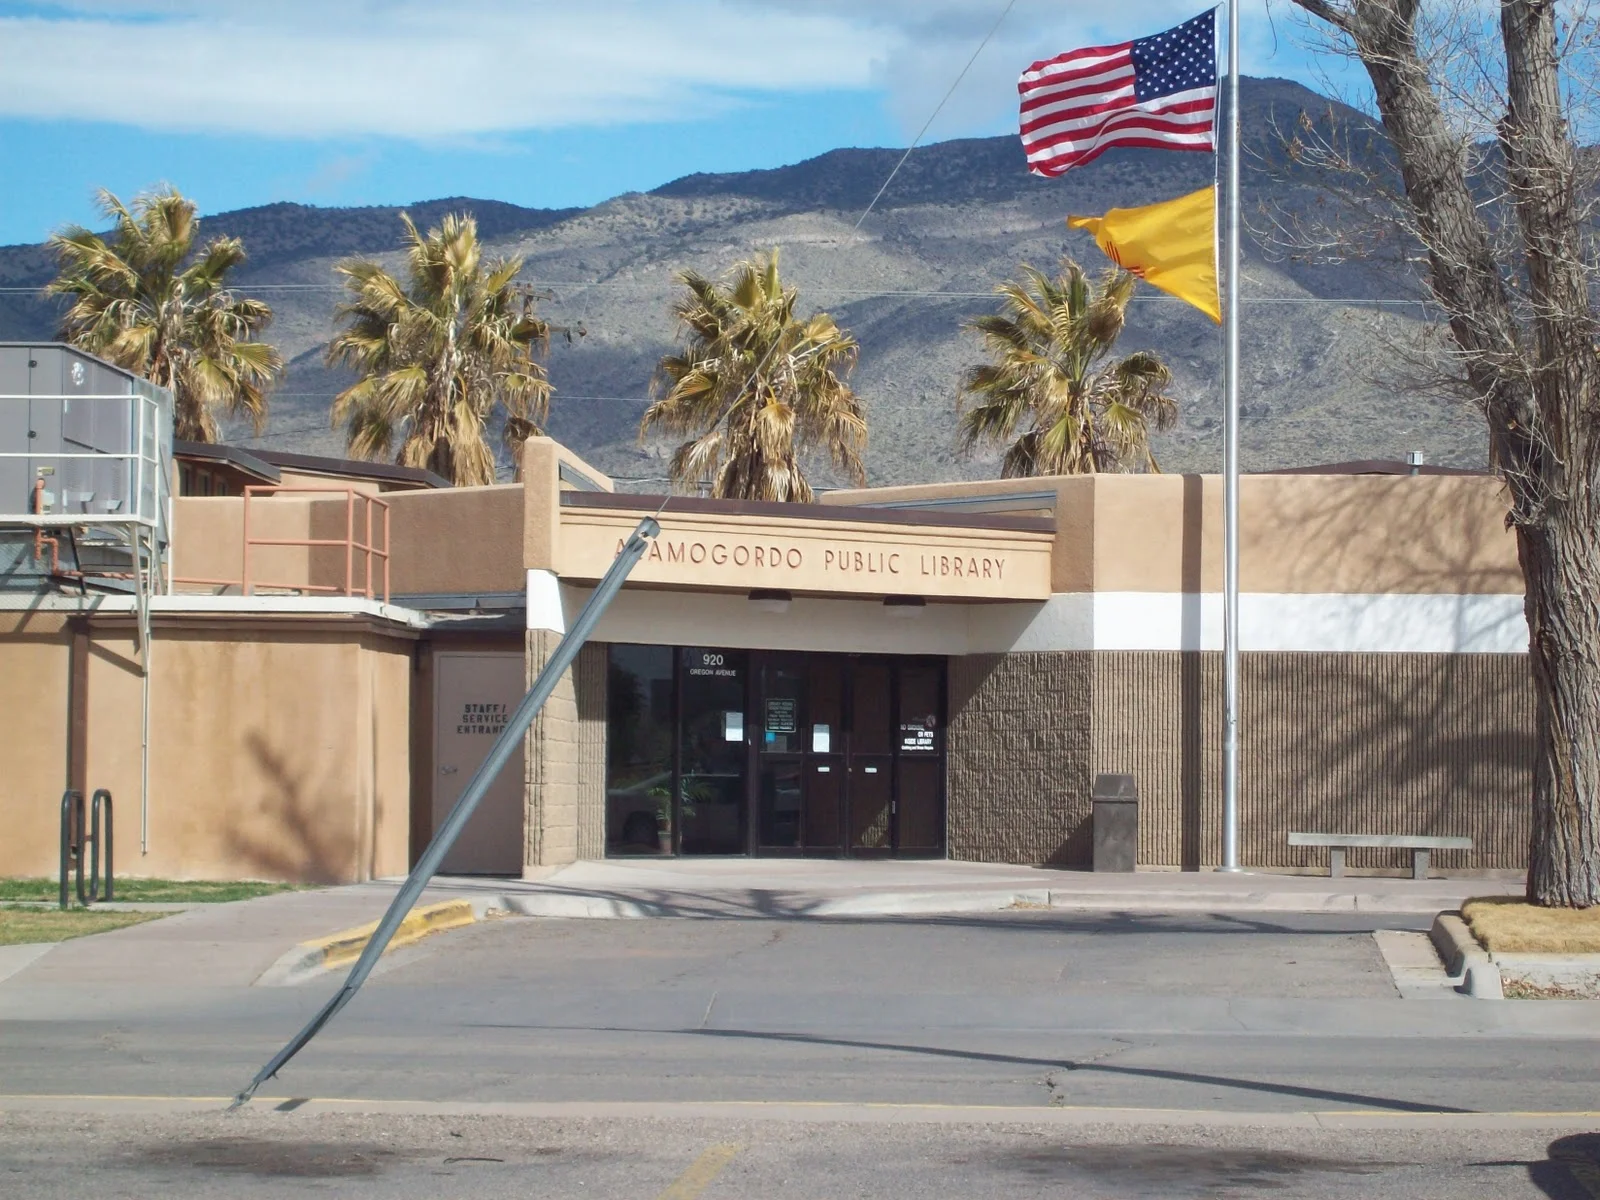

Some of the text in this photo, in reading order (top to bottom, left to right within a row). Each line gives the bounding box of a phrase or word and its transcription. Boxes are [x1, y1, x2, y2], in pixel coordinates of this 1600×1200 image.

[614, 538, 1006, 580] AAMOGORDO PUBLIC LIBRARY
[703, 654, 724, 666] 920
[690, 668, 736, 677] OREGON AVENUE
[462, 714, 508, 723] SERVICE
[457, 725, 505, 734] ENTRANC
